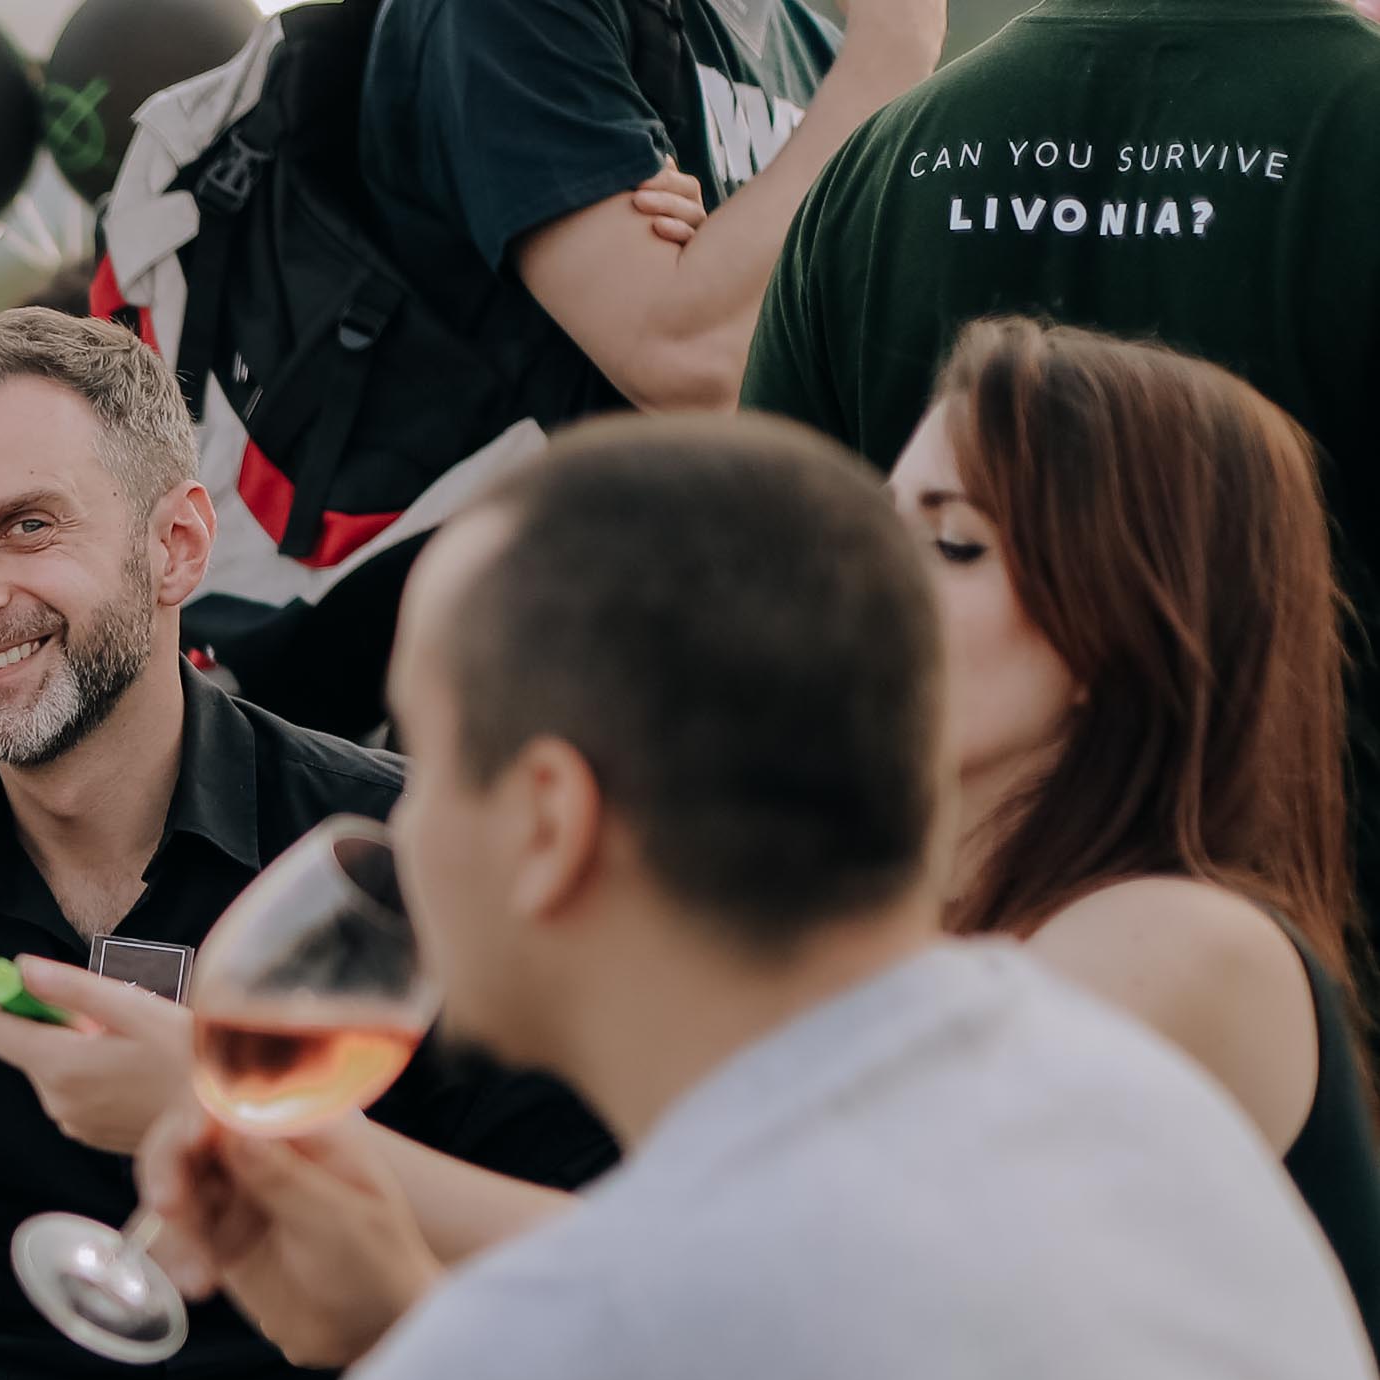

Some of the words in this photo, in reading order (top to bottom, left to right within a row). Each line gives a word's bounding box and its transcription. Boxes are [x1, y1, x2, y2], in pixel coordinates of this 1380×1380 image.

[909, 141, 983, 178] CAN
[1008, 140, 1093, 169] YOU
[1117, 143, 1289, 179] SURVIVE
[948, 197, 1215, 236] LIVONIA?
